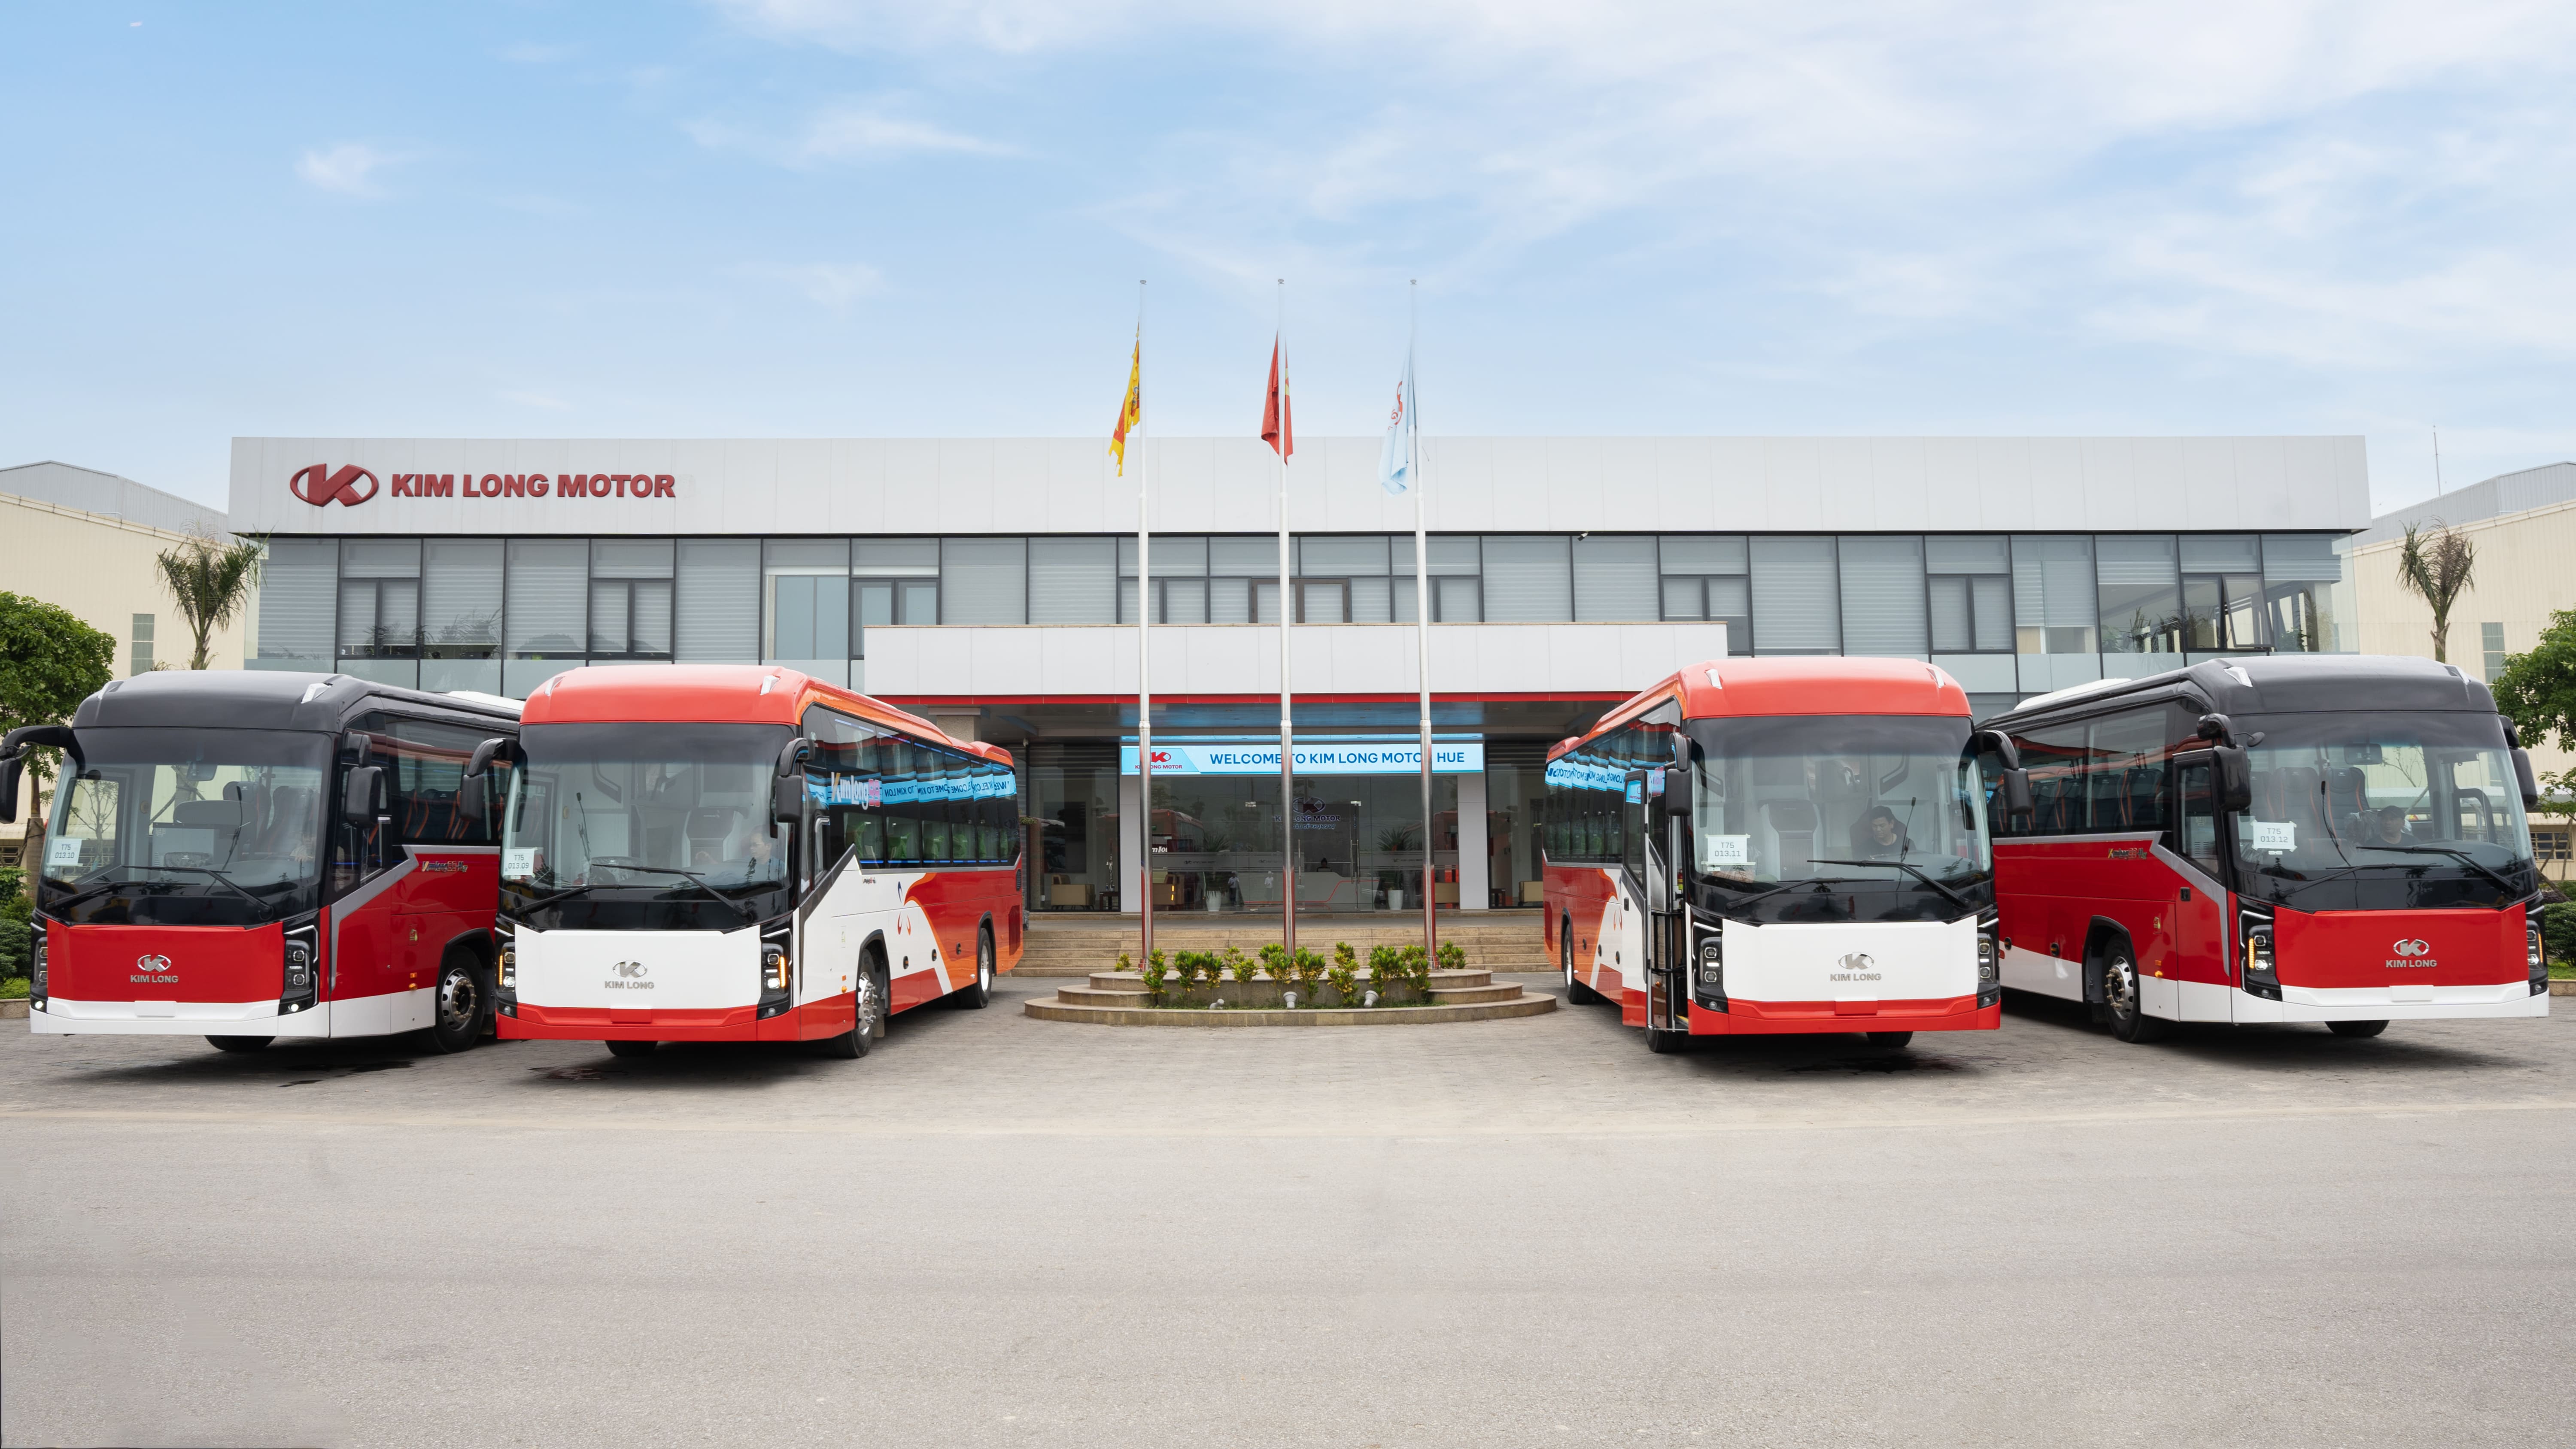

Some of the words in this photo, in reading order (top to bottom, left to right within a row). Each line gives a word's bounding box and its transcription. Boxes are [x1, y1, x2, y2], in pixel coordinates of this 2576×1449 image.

[391, 473, 453, 497] KIM
[462, 473, 549, 497] LONG
[557, 474, 676, 497] MOTOR
[1210, 754, 1282, 764] WELCOME
[1310, 753, 1334, 764] KIM
[1339, 753, 1378, 763] LONG
[1382, 753, 1432, 763] MOTO
[1437, 752, 1464, 763] HUE
[2385, 960, 2406, 968] KIM
[130, 975, 150, 983] KIM
[605, 981, 625, 989] KIM
